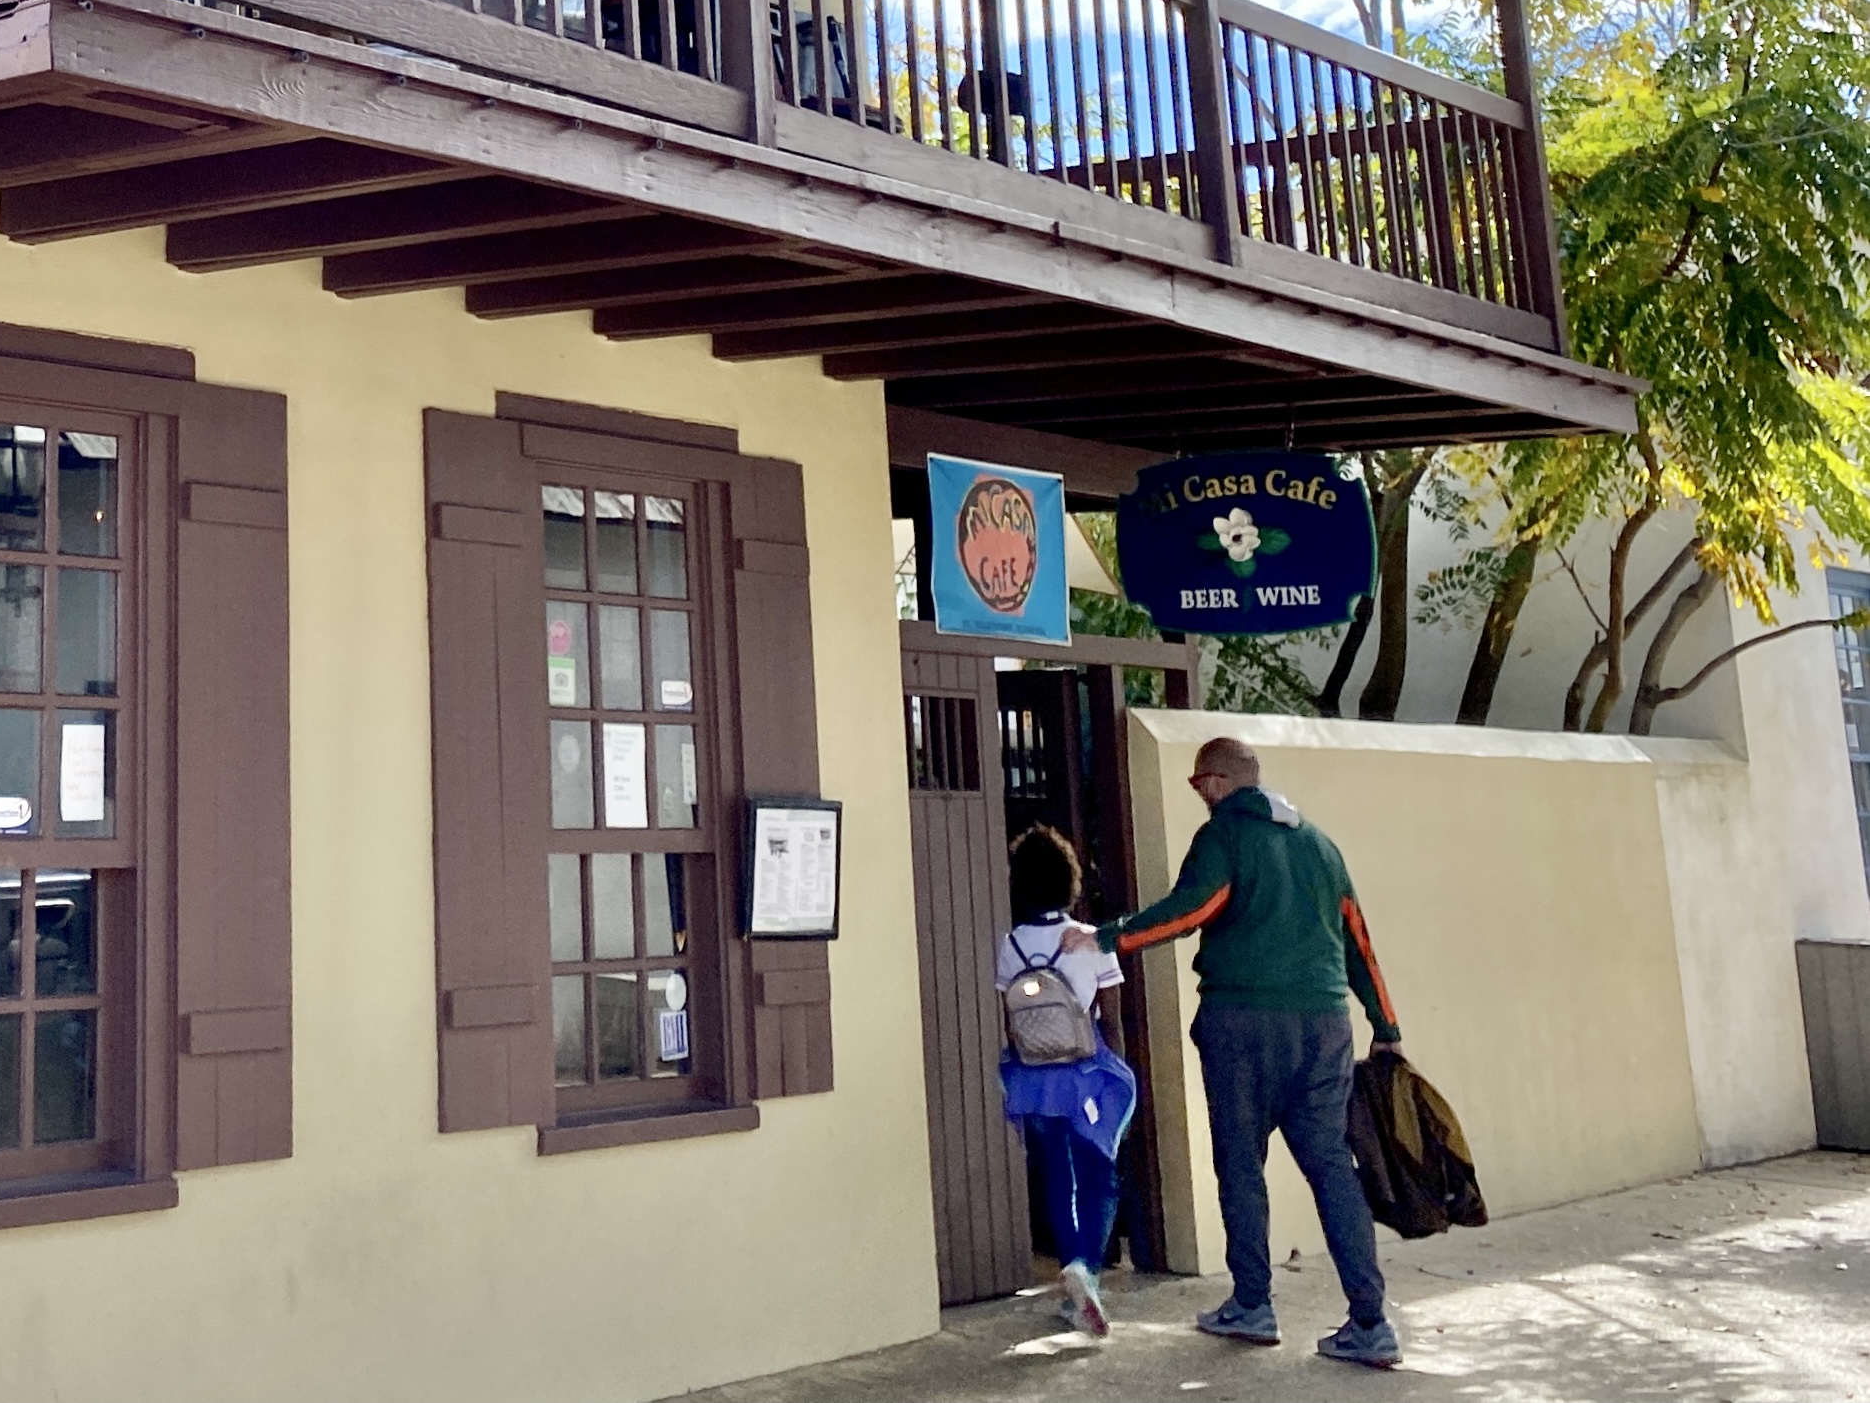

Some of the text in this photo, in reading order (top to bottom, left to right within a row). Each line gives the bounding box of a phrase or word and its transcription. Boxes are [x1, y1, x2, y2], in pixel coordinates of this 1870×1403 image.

[1182, 474, 1257, 502] Casa
[1265, 469, 1337, 510] Cafe
[979, 556, 1019, 595] CAFE
[1180, 585, 1321, 610] BEER WINE
